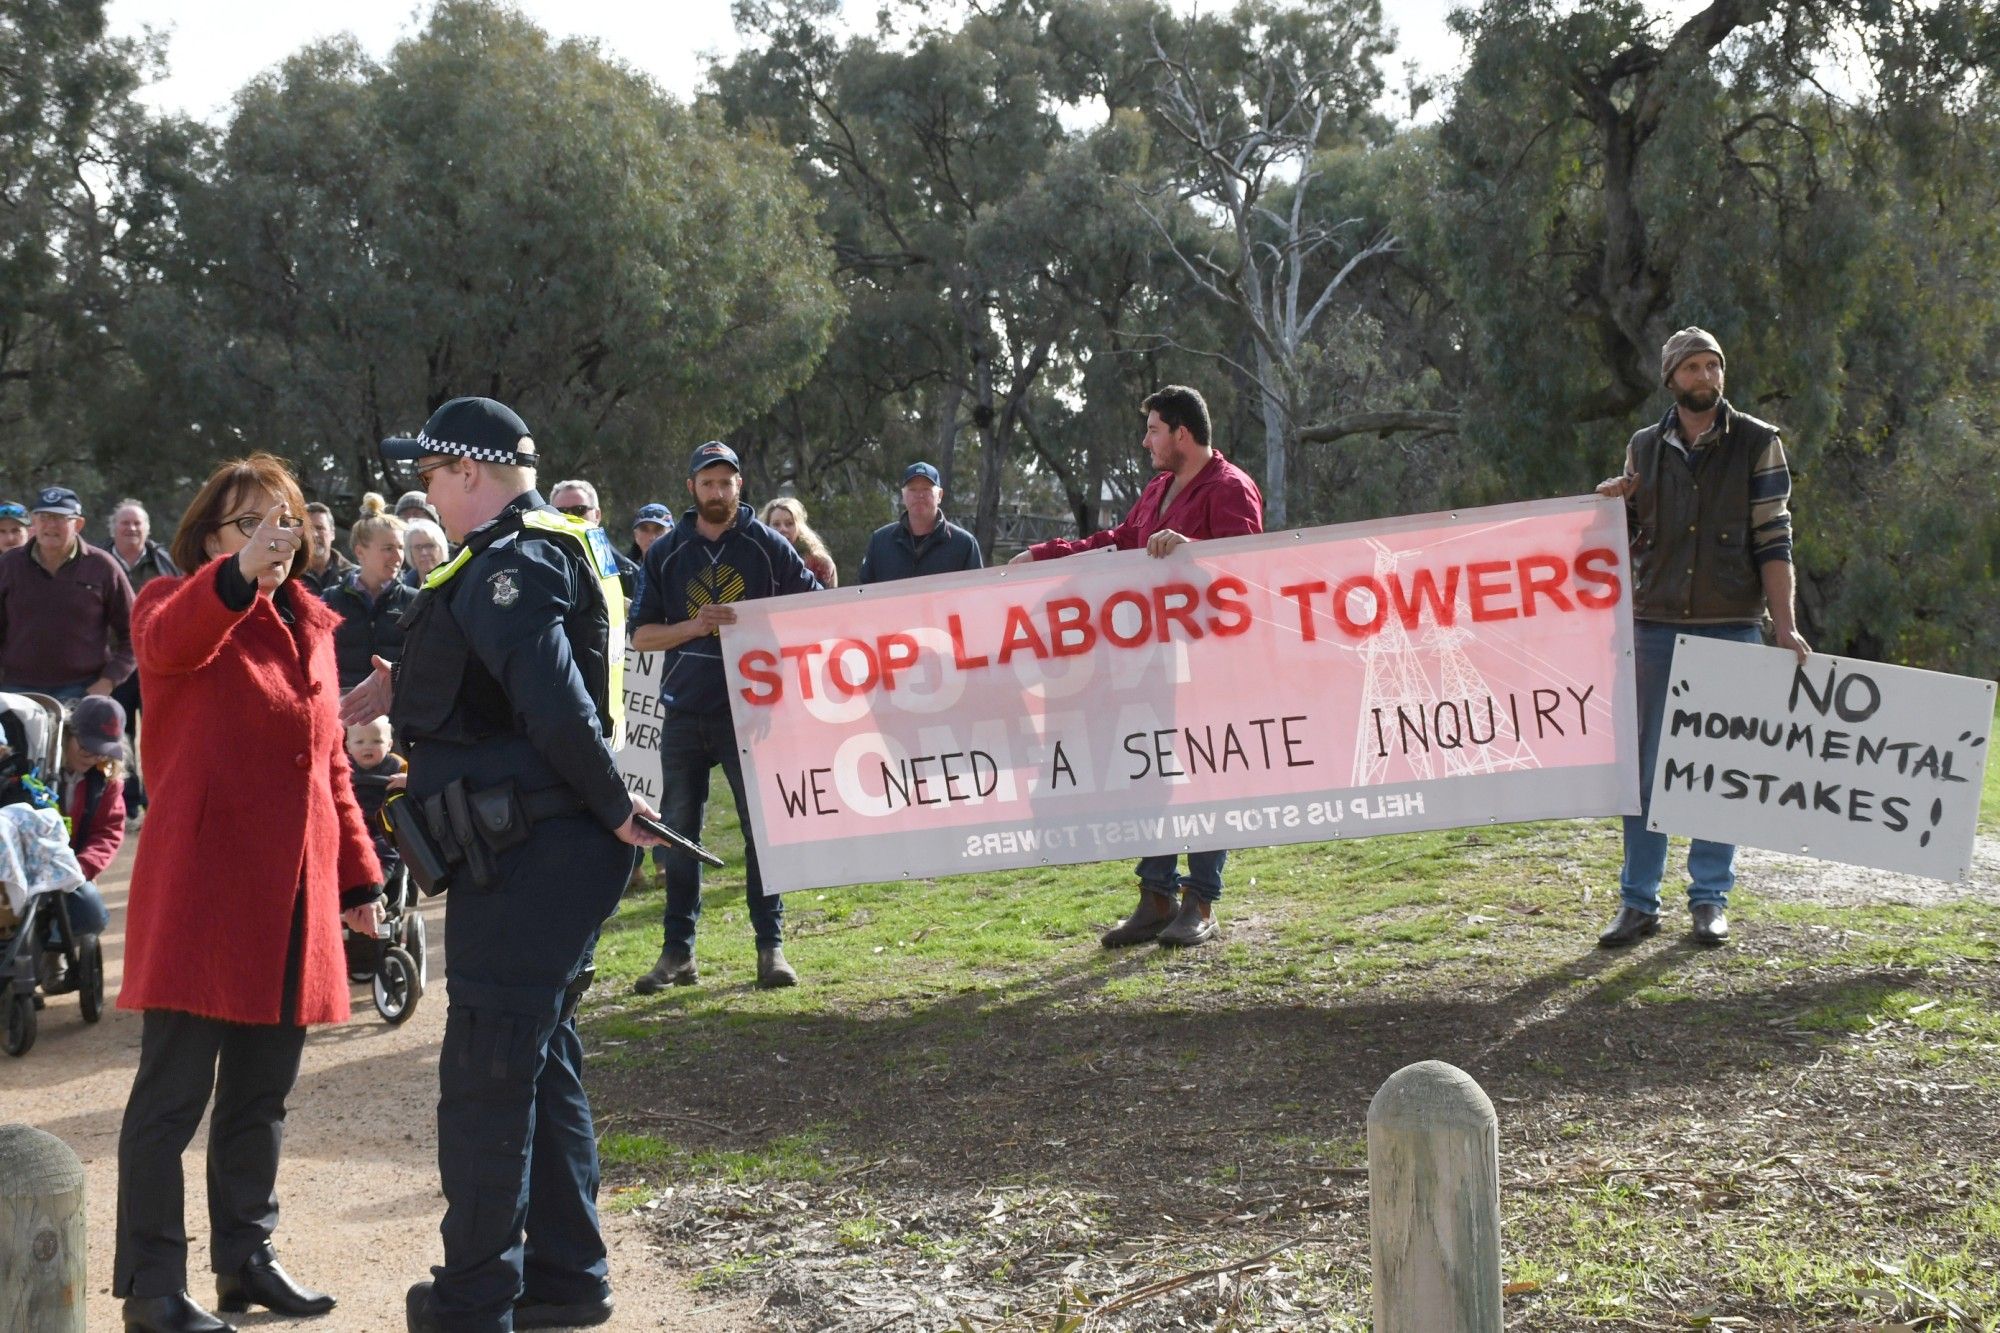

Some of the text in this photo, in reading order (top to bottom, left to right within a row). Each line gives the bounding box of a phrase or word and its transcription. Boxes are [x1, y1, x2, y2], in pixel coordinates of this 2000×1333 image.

[739, 547, 1621, 706] STOP LABORS TOWERS
[624, 647, 654, 676] EN
[622, 689, 665, 720] TEEL
[1788, 663, 1881, 724] NO
[625, 721, 664, 752] WER
[777, 685, 1594, 818] WE NEED A SENATE INQUIRY
[622, 771, 656, 798] TAL
[1664, 757, 1943, 848] MISTAKES!
